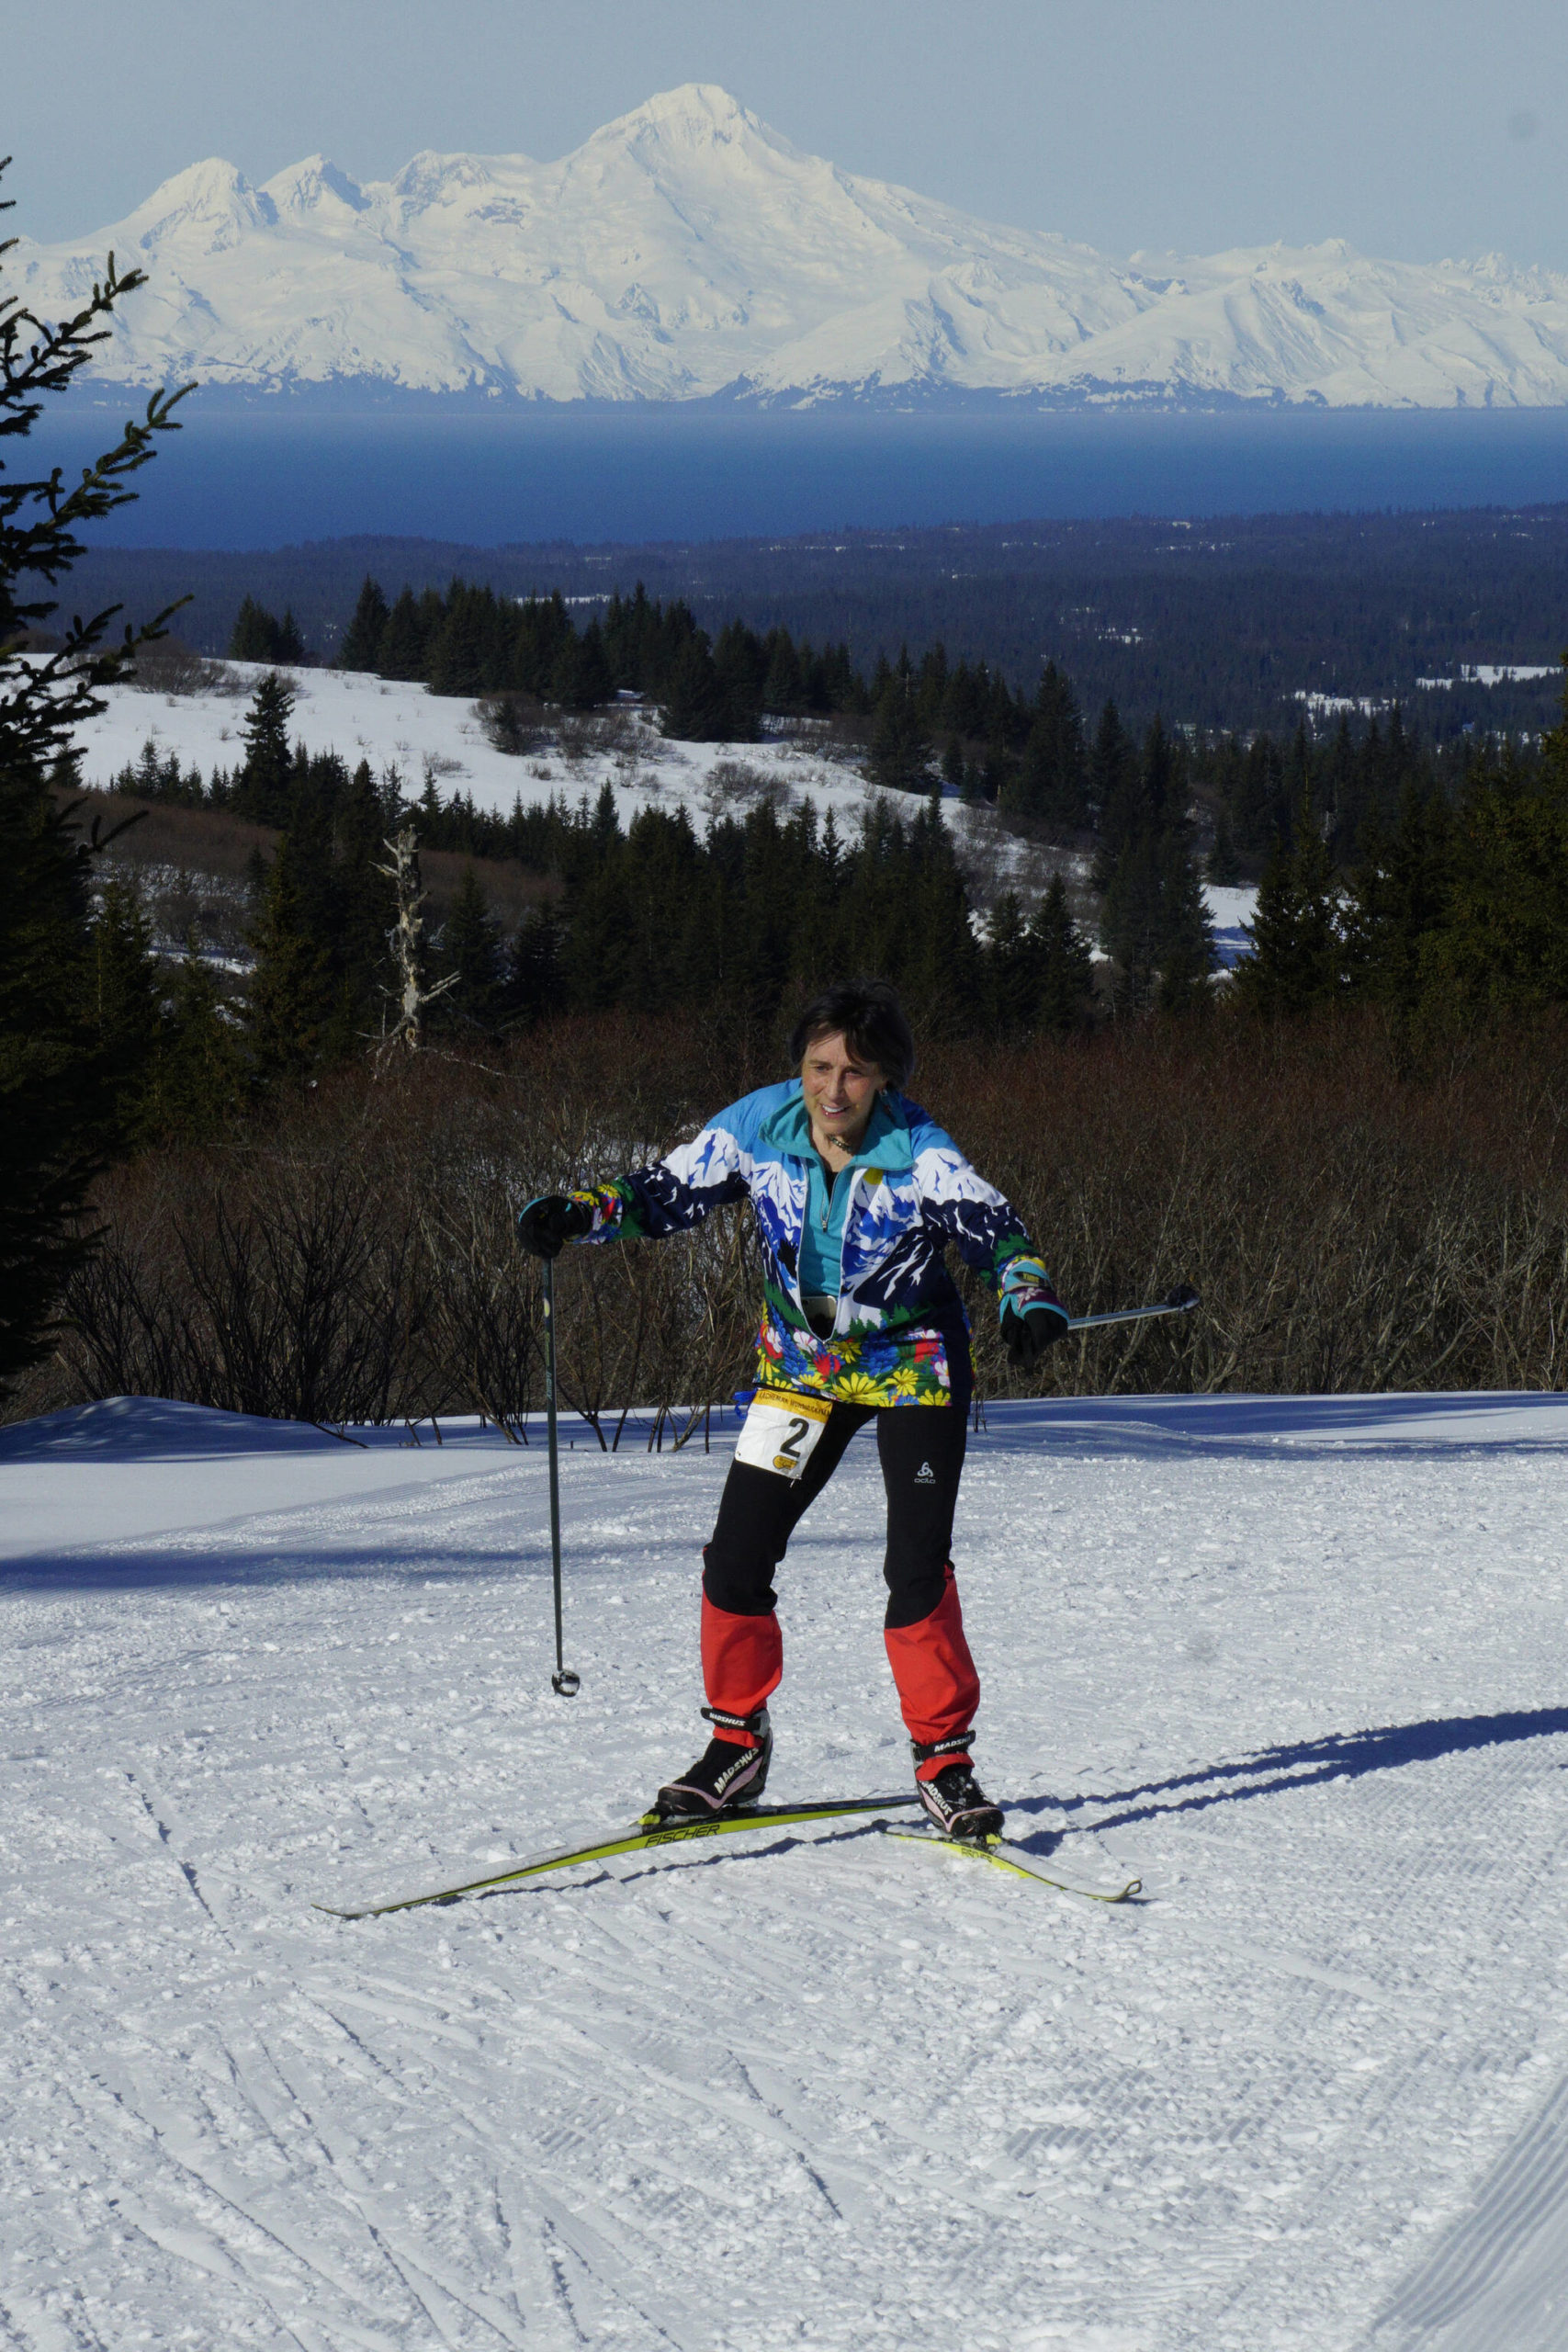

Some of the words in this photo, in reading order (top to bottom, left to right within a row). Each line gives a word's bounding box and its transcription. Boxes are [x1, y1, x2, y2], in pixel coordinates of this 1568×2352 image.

[780, 1418, 809, 1458] 2
[709, 1713, 746, 1726] MADSHUS
[934, 1736, 970, 1753] MADSH
[714, 1747, 759, 1794] MADSHUS
[645, 1825, 720, 1848] FISCHER
